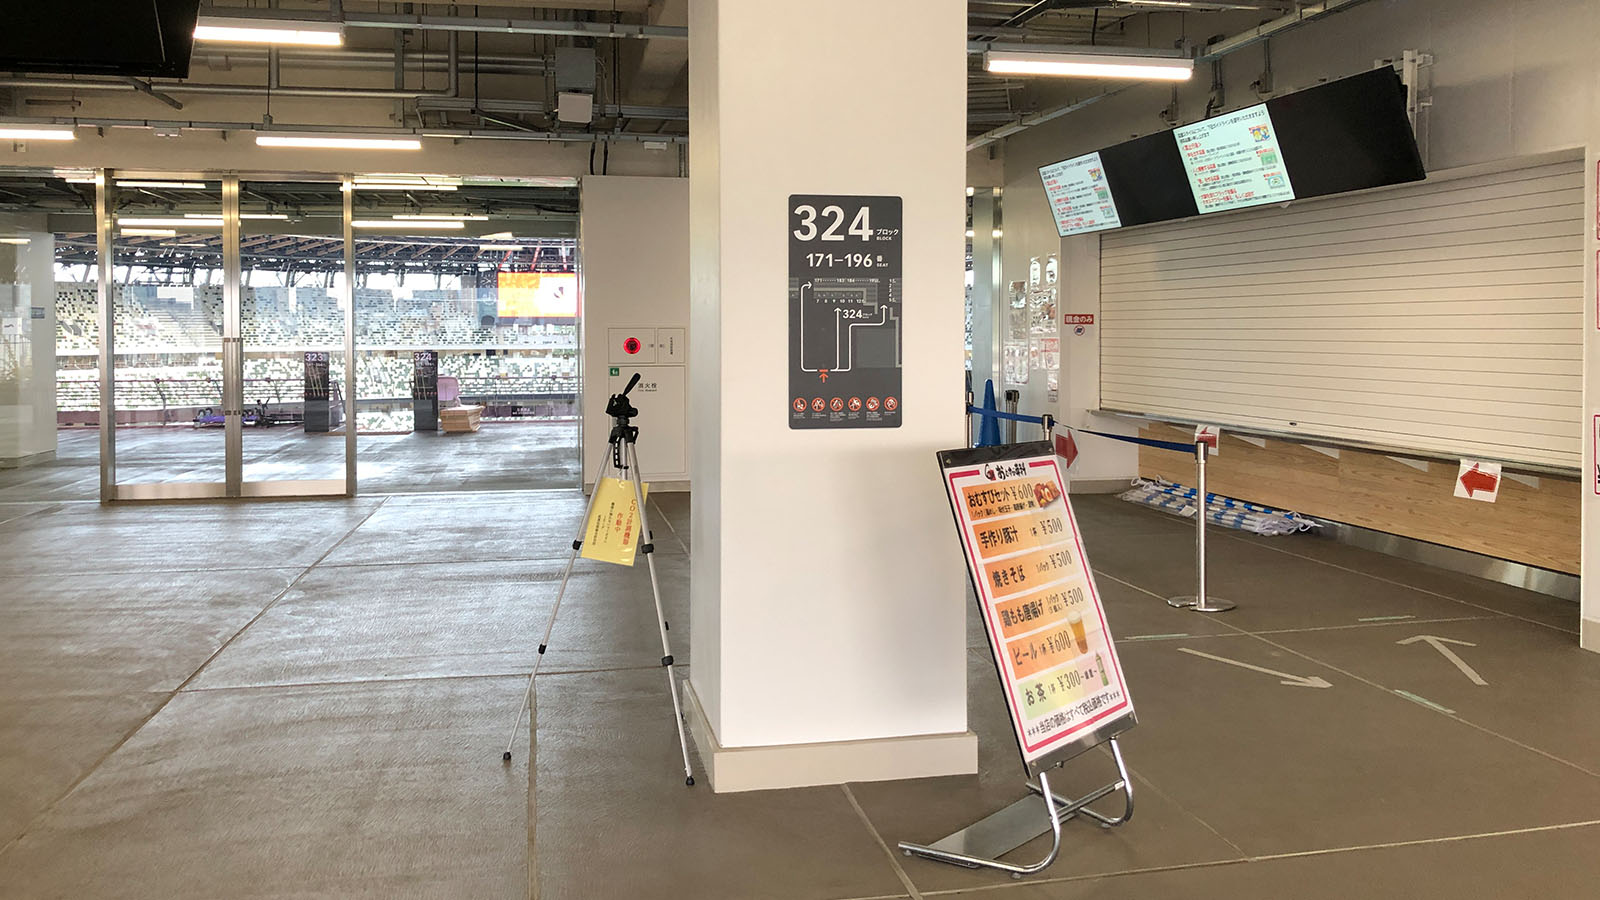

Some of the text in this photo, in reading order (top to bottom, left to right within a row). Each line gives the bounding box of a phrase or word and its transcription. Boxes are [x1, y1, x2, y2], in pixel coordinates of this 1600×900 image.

[793, 204, 874, 242] 324
[806, 253, 873, 268] 171-196
[842, 309, 863, 319] 324
[1065, 315, 1093, 324] 現金のみ
[305, 353, 324, 362] 323
[414, 353, 433, 361] 324
[967, 483, 1034, 508] おむすびセット ¥600
[979, 525, 1020, 549] 手作り豚汁
[1040, 517, 1063, 535] ¥500
[992, 564, 1026, 589] 焼きそば
[1048, 550, 1072, 571] ¥500
[1001, 600, 1044, 628] 鶏もも唐揚げ
[1061, 587, 1084, 607] ¥500
[1011, 641, 1038, 667] ビール
[1046, 630, 1072, 654] ¥600
[1025, 682, 1047, 706] お茶
[1057, 669, 1081, 693] ¥300
